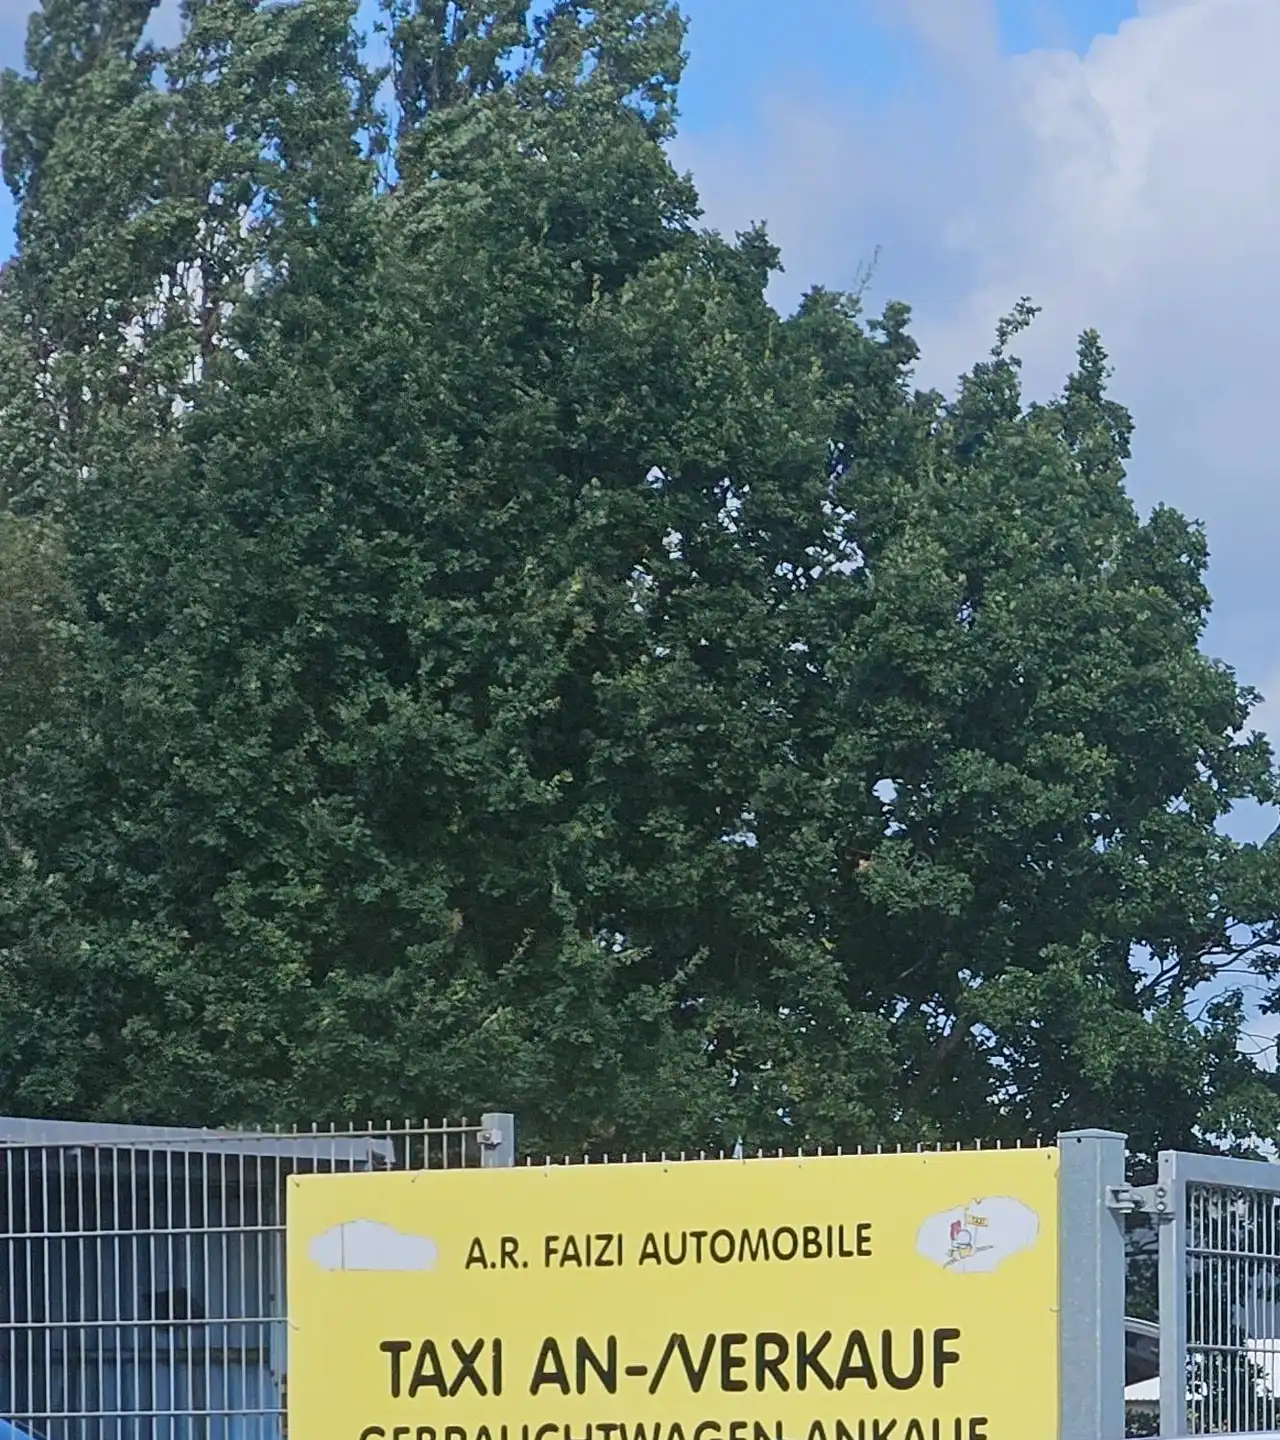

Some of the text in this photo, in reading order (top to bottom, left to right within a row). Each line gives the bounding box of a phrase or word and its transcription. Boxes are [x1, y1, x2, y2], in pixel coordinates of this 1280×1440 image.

[464, 1222, 873, 1270] A.R. FAIZI AUTOMOBILE
[379, 1336, 503, 1399] TAXI
